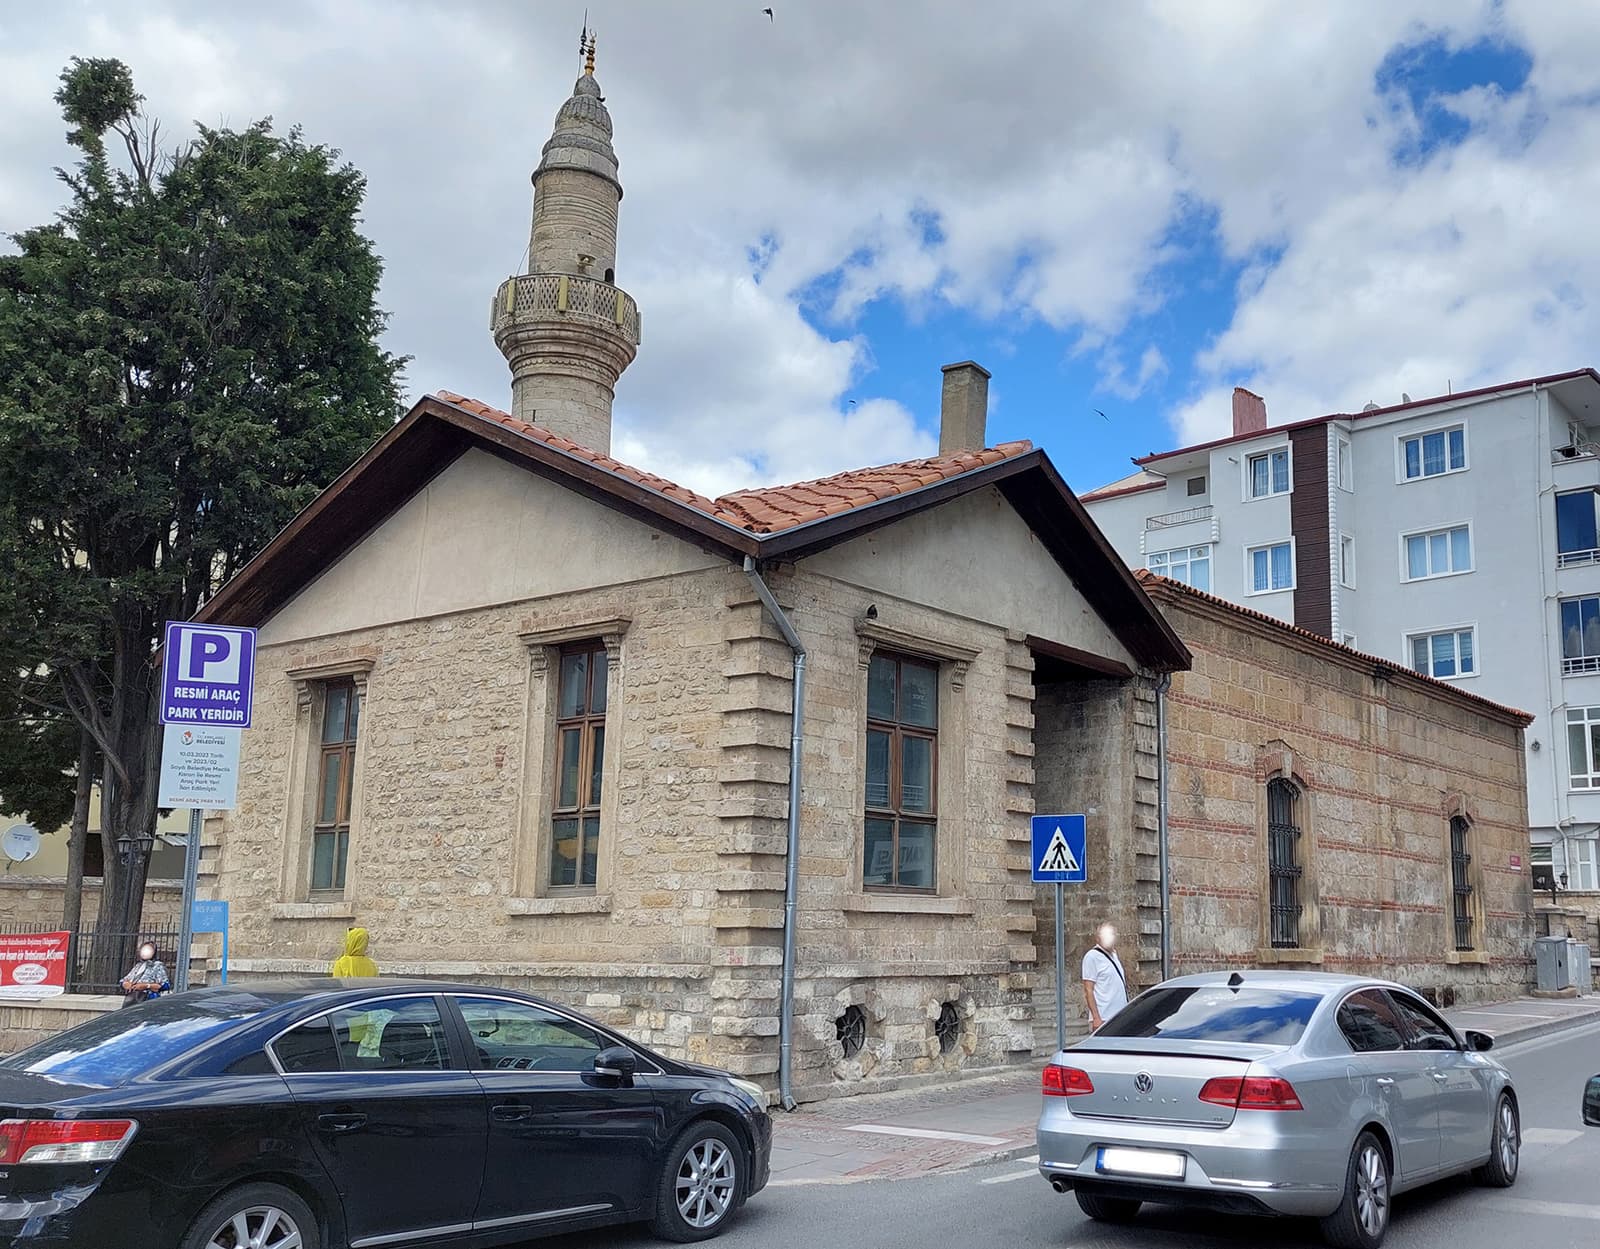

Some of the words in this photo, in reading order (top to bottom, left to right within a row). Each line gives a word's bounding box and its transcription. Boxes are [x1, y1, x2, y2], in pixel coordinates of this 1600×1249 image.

[189, 633, 231, 678] P
[174, 685, 209, 699] RESMİ
[211, 689, 241, 704] ARAÇ
[168, 706, 197, 719] PARK
[200, 706, 244, 721] YERİDİR
